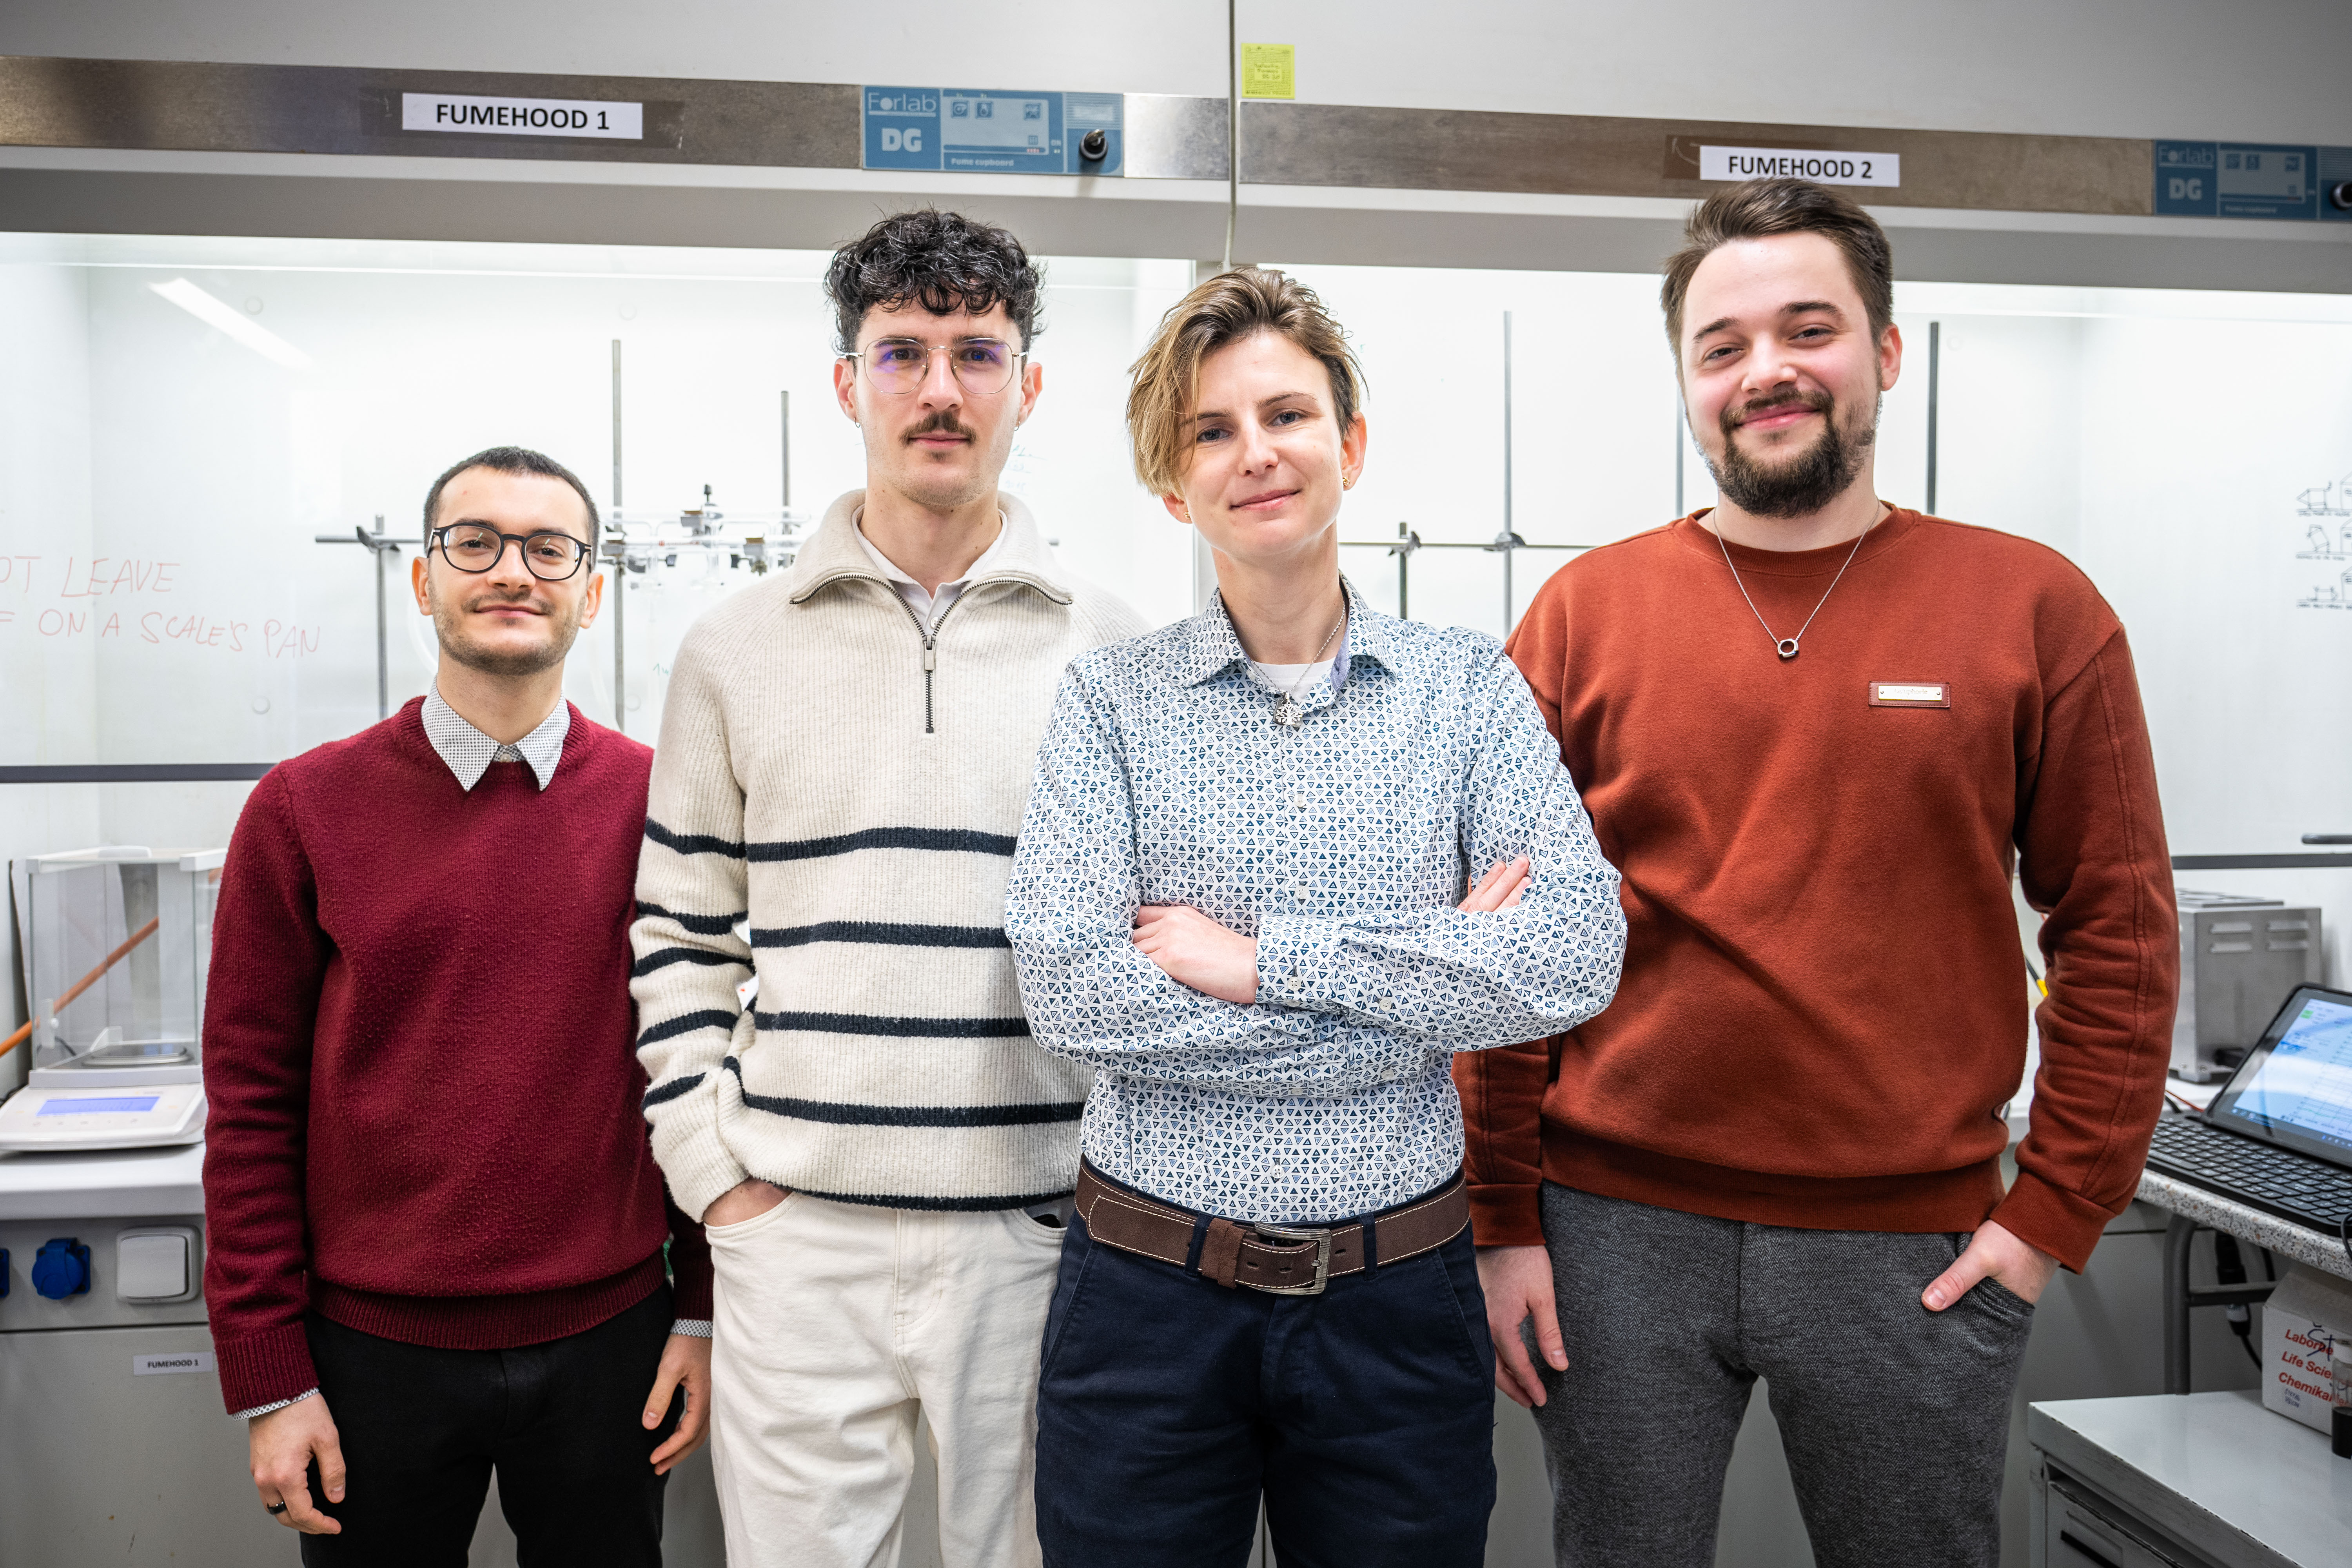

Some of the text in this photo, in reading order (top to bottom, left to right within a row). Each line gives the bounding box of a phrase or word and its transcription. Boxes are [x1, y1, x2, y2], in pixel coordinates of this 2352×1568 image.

[867, 92, 937, 113] Forlab
[436, 103, 610, 130] FUMEHOOD 1
[881, 127, 922, 152] DG
[1728, 155, 1873, 179] FUMEHOOD 2
[2168, 178, 2202, 200] DG
[61, 556, 181, 598] LEAVE
[38, 608, 86, 637] ON
[102, 612, 120, 638] A
[264, 619, 321, 659] PAN
[148, 1359, 192, 1368] FUMEHOOD
[2281, 1350, 2304, 1368] Life
